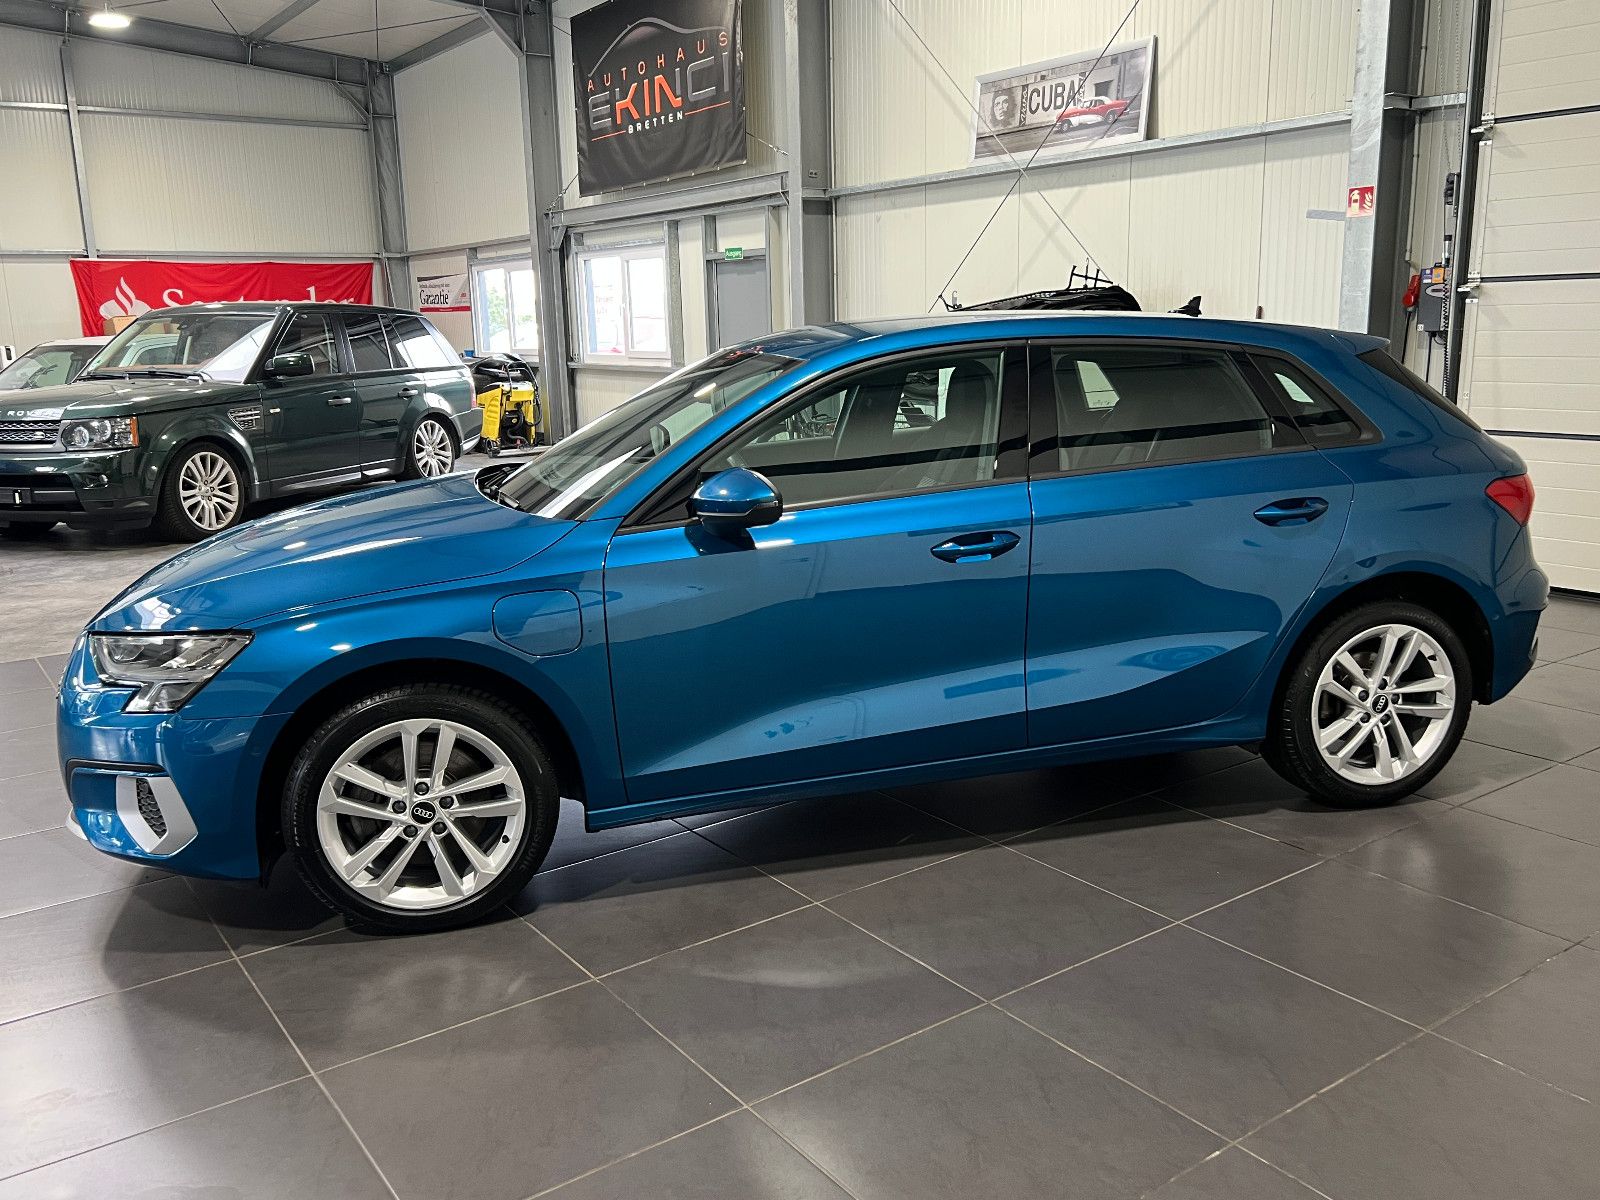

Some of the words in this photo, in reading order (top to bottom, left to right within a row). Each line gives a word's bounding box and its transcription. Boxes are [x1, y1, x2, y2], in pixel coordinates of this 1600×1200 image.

[587, 32, 728, 92] AUTOHAUS
[588, 52, 730, 131] EKINCI
[1029, 80, 1077, 115] CUBA
[628, 111, 683, 134] BRETTEN
